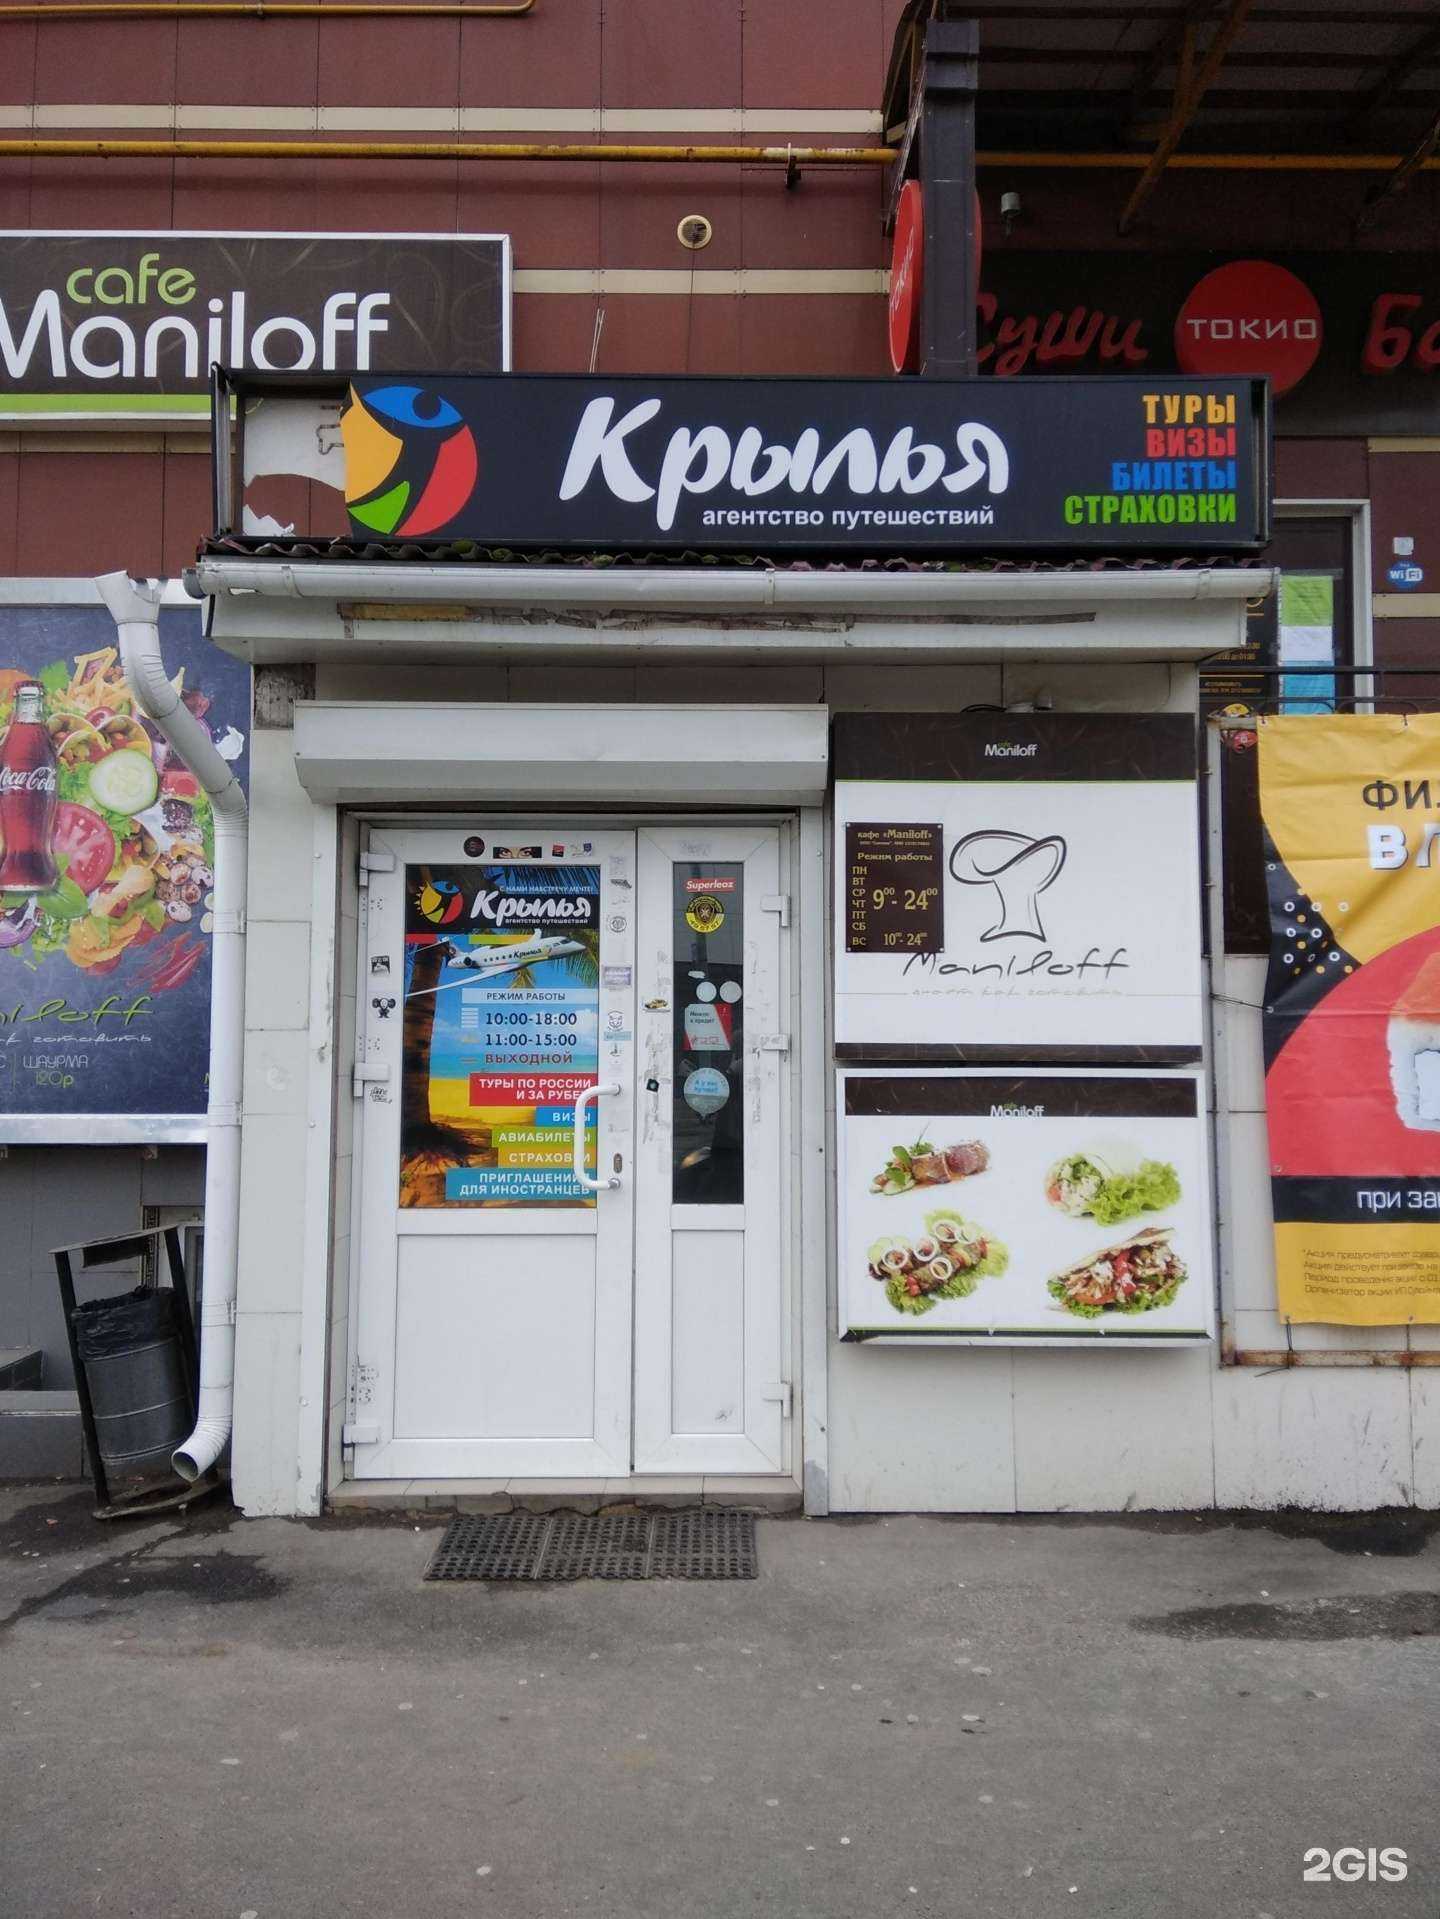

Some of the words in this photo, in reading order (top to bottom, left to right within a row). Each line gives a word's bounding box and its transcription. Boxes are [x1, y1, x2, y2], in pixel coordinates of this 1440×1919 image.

[66, 253, 196, 304] cafe
[1187, 318, 1317, 340] ТОКИО
[1142, 395, 1236, 424] ТУРЫ
[1146, 428, 1236, 457] ВИЗЫ
[558, 396, 1009, 531] Крылья
[1111, 461, 1237, 491] БИЛЕТЫ
[1065, 494, 1236, 524] СТРАХОВКИ
[702, 509, 824, 529] агентство
[832, 505, 994, 530] путешествий
[984, 743, 1038, 757] Maniloff
[1363, 780, 1440, 810] ФИ
[857, 852, 892, 860] Режим
[895, 853, 933, 862] работы
[852, 866, 867, 875] ПН
[852, 877, 865, 885] ВТ
[852, 888, 866, 897] СР
[470, 890, 591, 926] Крылья
[852, 899, 866, 908] ЧТ
[852, 911, 866, 919] ПТ
[852, 922, 866, 930] СБ
[852, 937, 866, 946] ВС
[526, 992, 566, 1001] РАБОТЫ
[0, 996, 154, 1025] iloff
[485, 1013, 577, 1025] 10:00-18:00
[485, 1034, 577, 1046] 11:00-15:00
[485, 1051, 572, 1064] ВЫХОДНОЙ
[480, 1079, 514, 1088] ТУРЫ
[518, 1079, 536, 1088] ПО
[539, 1079, 591, 1088] РОССИИ
[516, 1091, 525, 1100] И
[529, 1091, 544, 1100] ЗА
[548, 1091, 583, 1100] РУБЕ
[552, 1113, 591, 1122] ВИЫ
[509, 1153, 590, 1162] СТРАХОВИ
[460, 1185, 487, 1196] ДЛЯ
[1357, 1191, 1401, 1213] при
[1408, 1191, 1440, 1208] за
